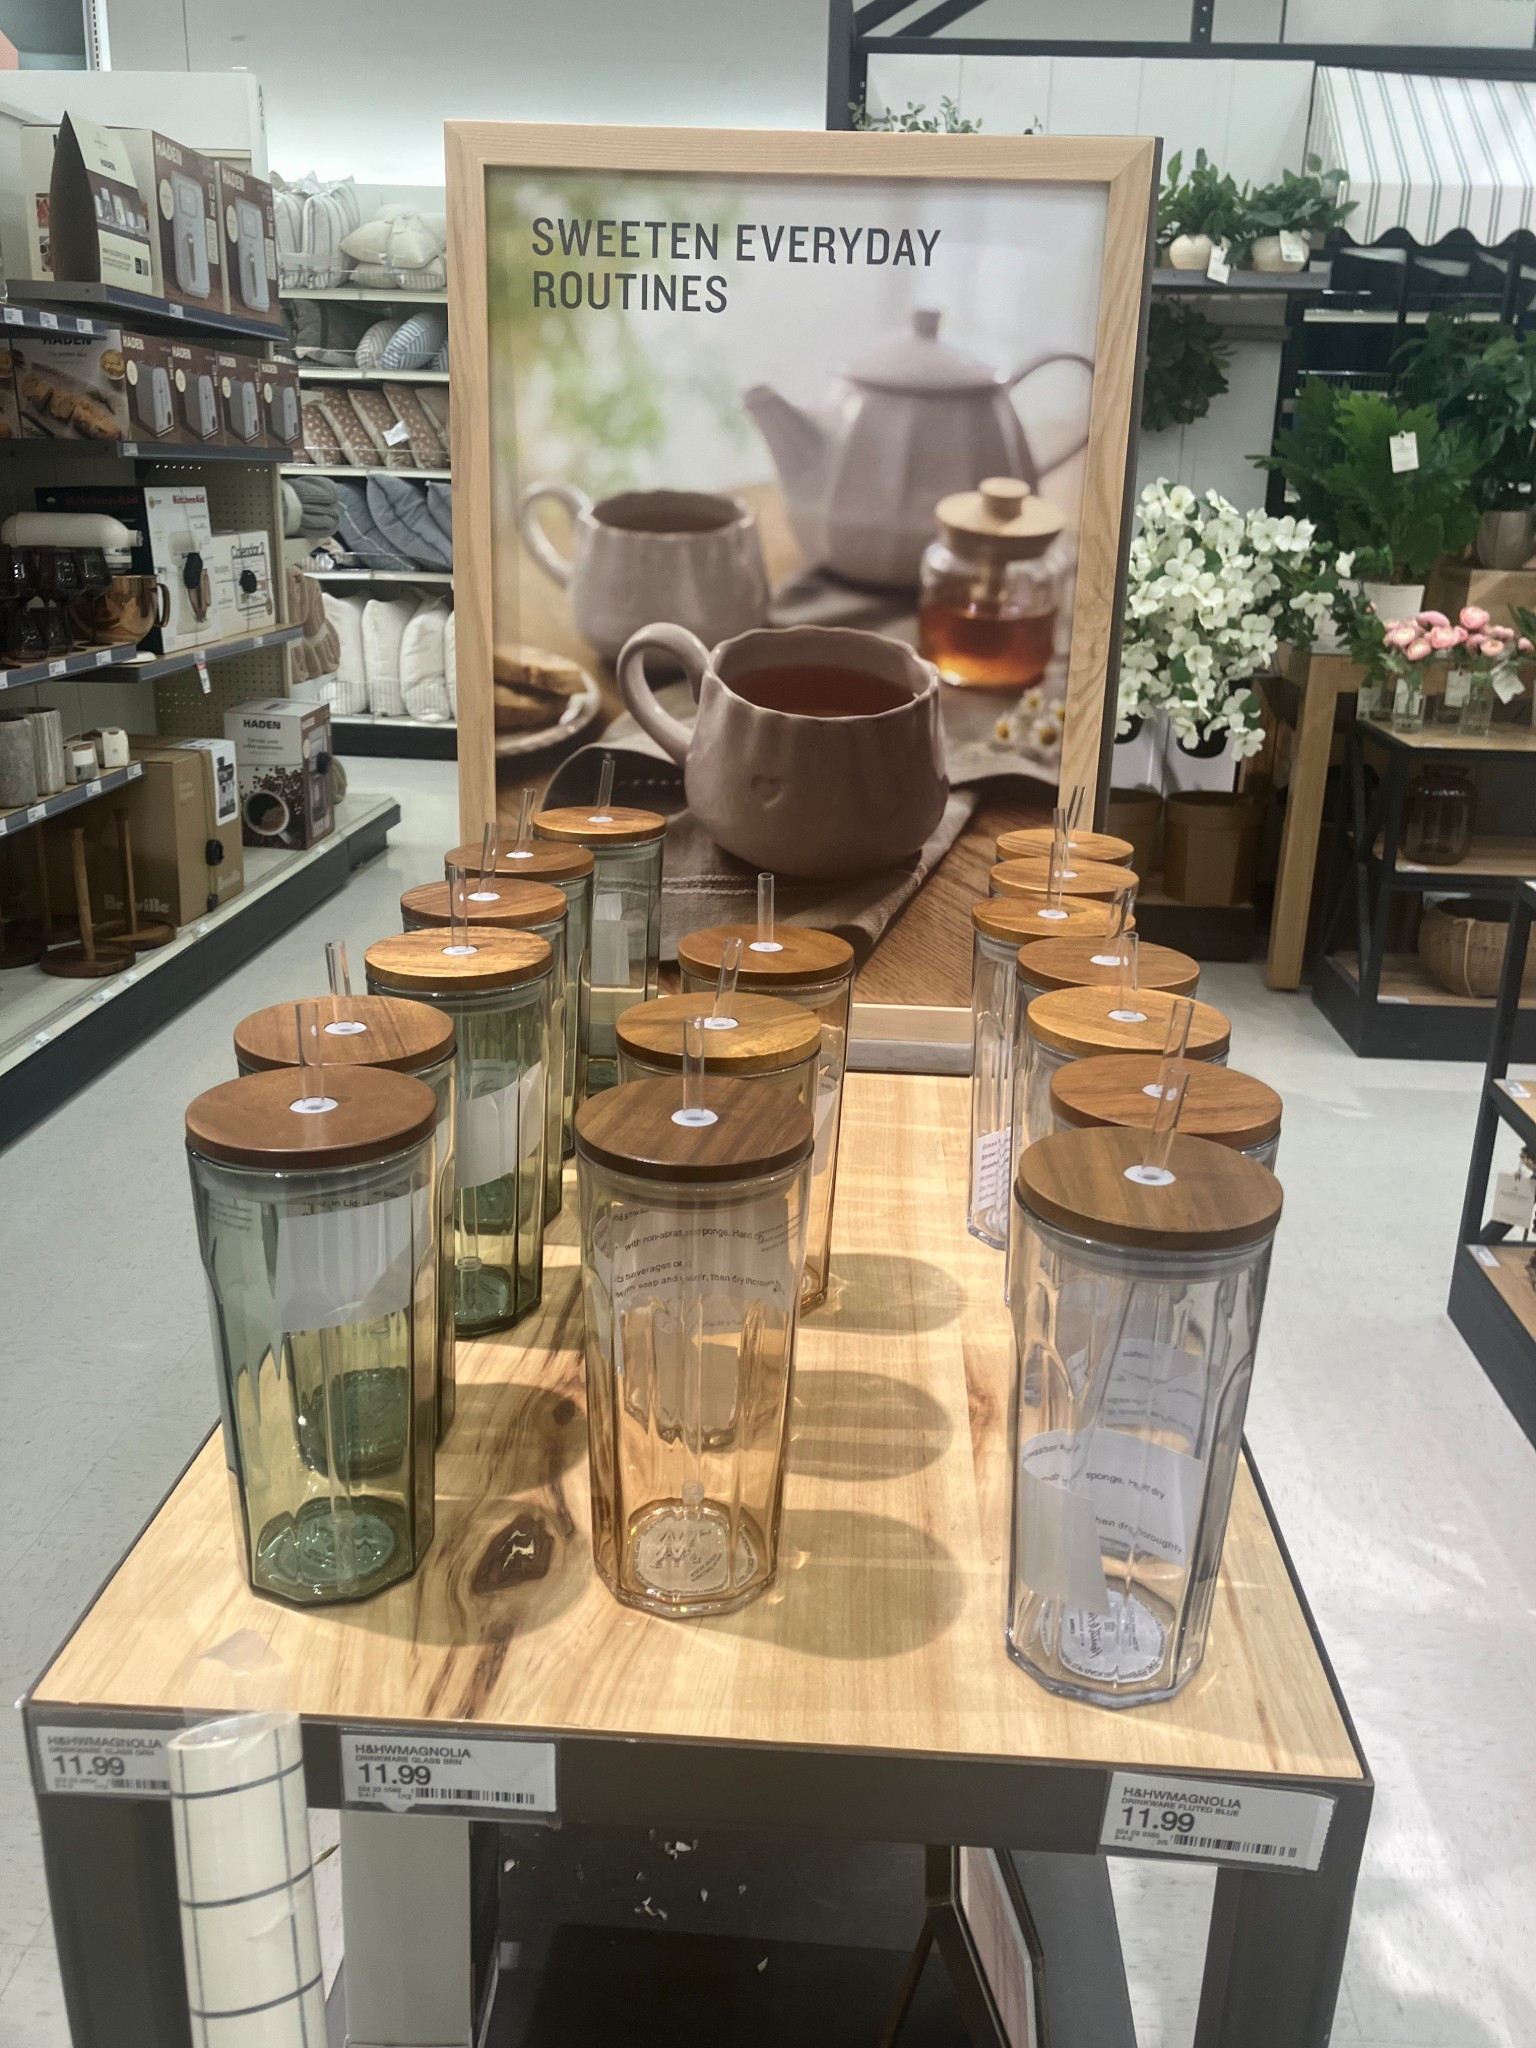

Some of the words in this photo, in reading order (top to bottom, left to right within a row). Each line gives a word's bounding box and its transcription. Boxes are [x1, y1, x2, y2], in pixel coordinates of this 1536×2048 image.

[155, 138, 182, 166] HADEN
[222, 168, 245, 191] HADEN
[531, 217, 719, 261] SWEETEN
[736, 224, 941, 267] EVERYDAY
[533, 270, 728, 314] ROUTINES
[123, 334, 144, 350] HADEN
[172, 345, 191, 360] HADEN
[218, 355, 236, 368] HADEN
[243, 719, 281, 730] HADEN
[103, 894, 171, 914] Brville
[1085, 1471, 1126, 1486] sponge.
[355, 1744, 472, 1758] H&HWMAGNOLIA
[355, 1754, 409, 1763] DRINKWARE
[411, 1756, 441, 1765] GLASS
[52, 1755, 125, 1776] 11.99
[358, 1763, 432, 1786] 11.99
[1121, 1797, 1176, 1809] DRINKWARE
[1178, 1803, 1213, 1814] FLUTED
[1215, 1808, 1240, 1817] BLUE
[1123, 1787, 1242, 1809] H&HWMAGNOLIA
[1121, 1806, 1195, 1833] 11.99
